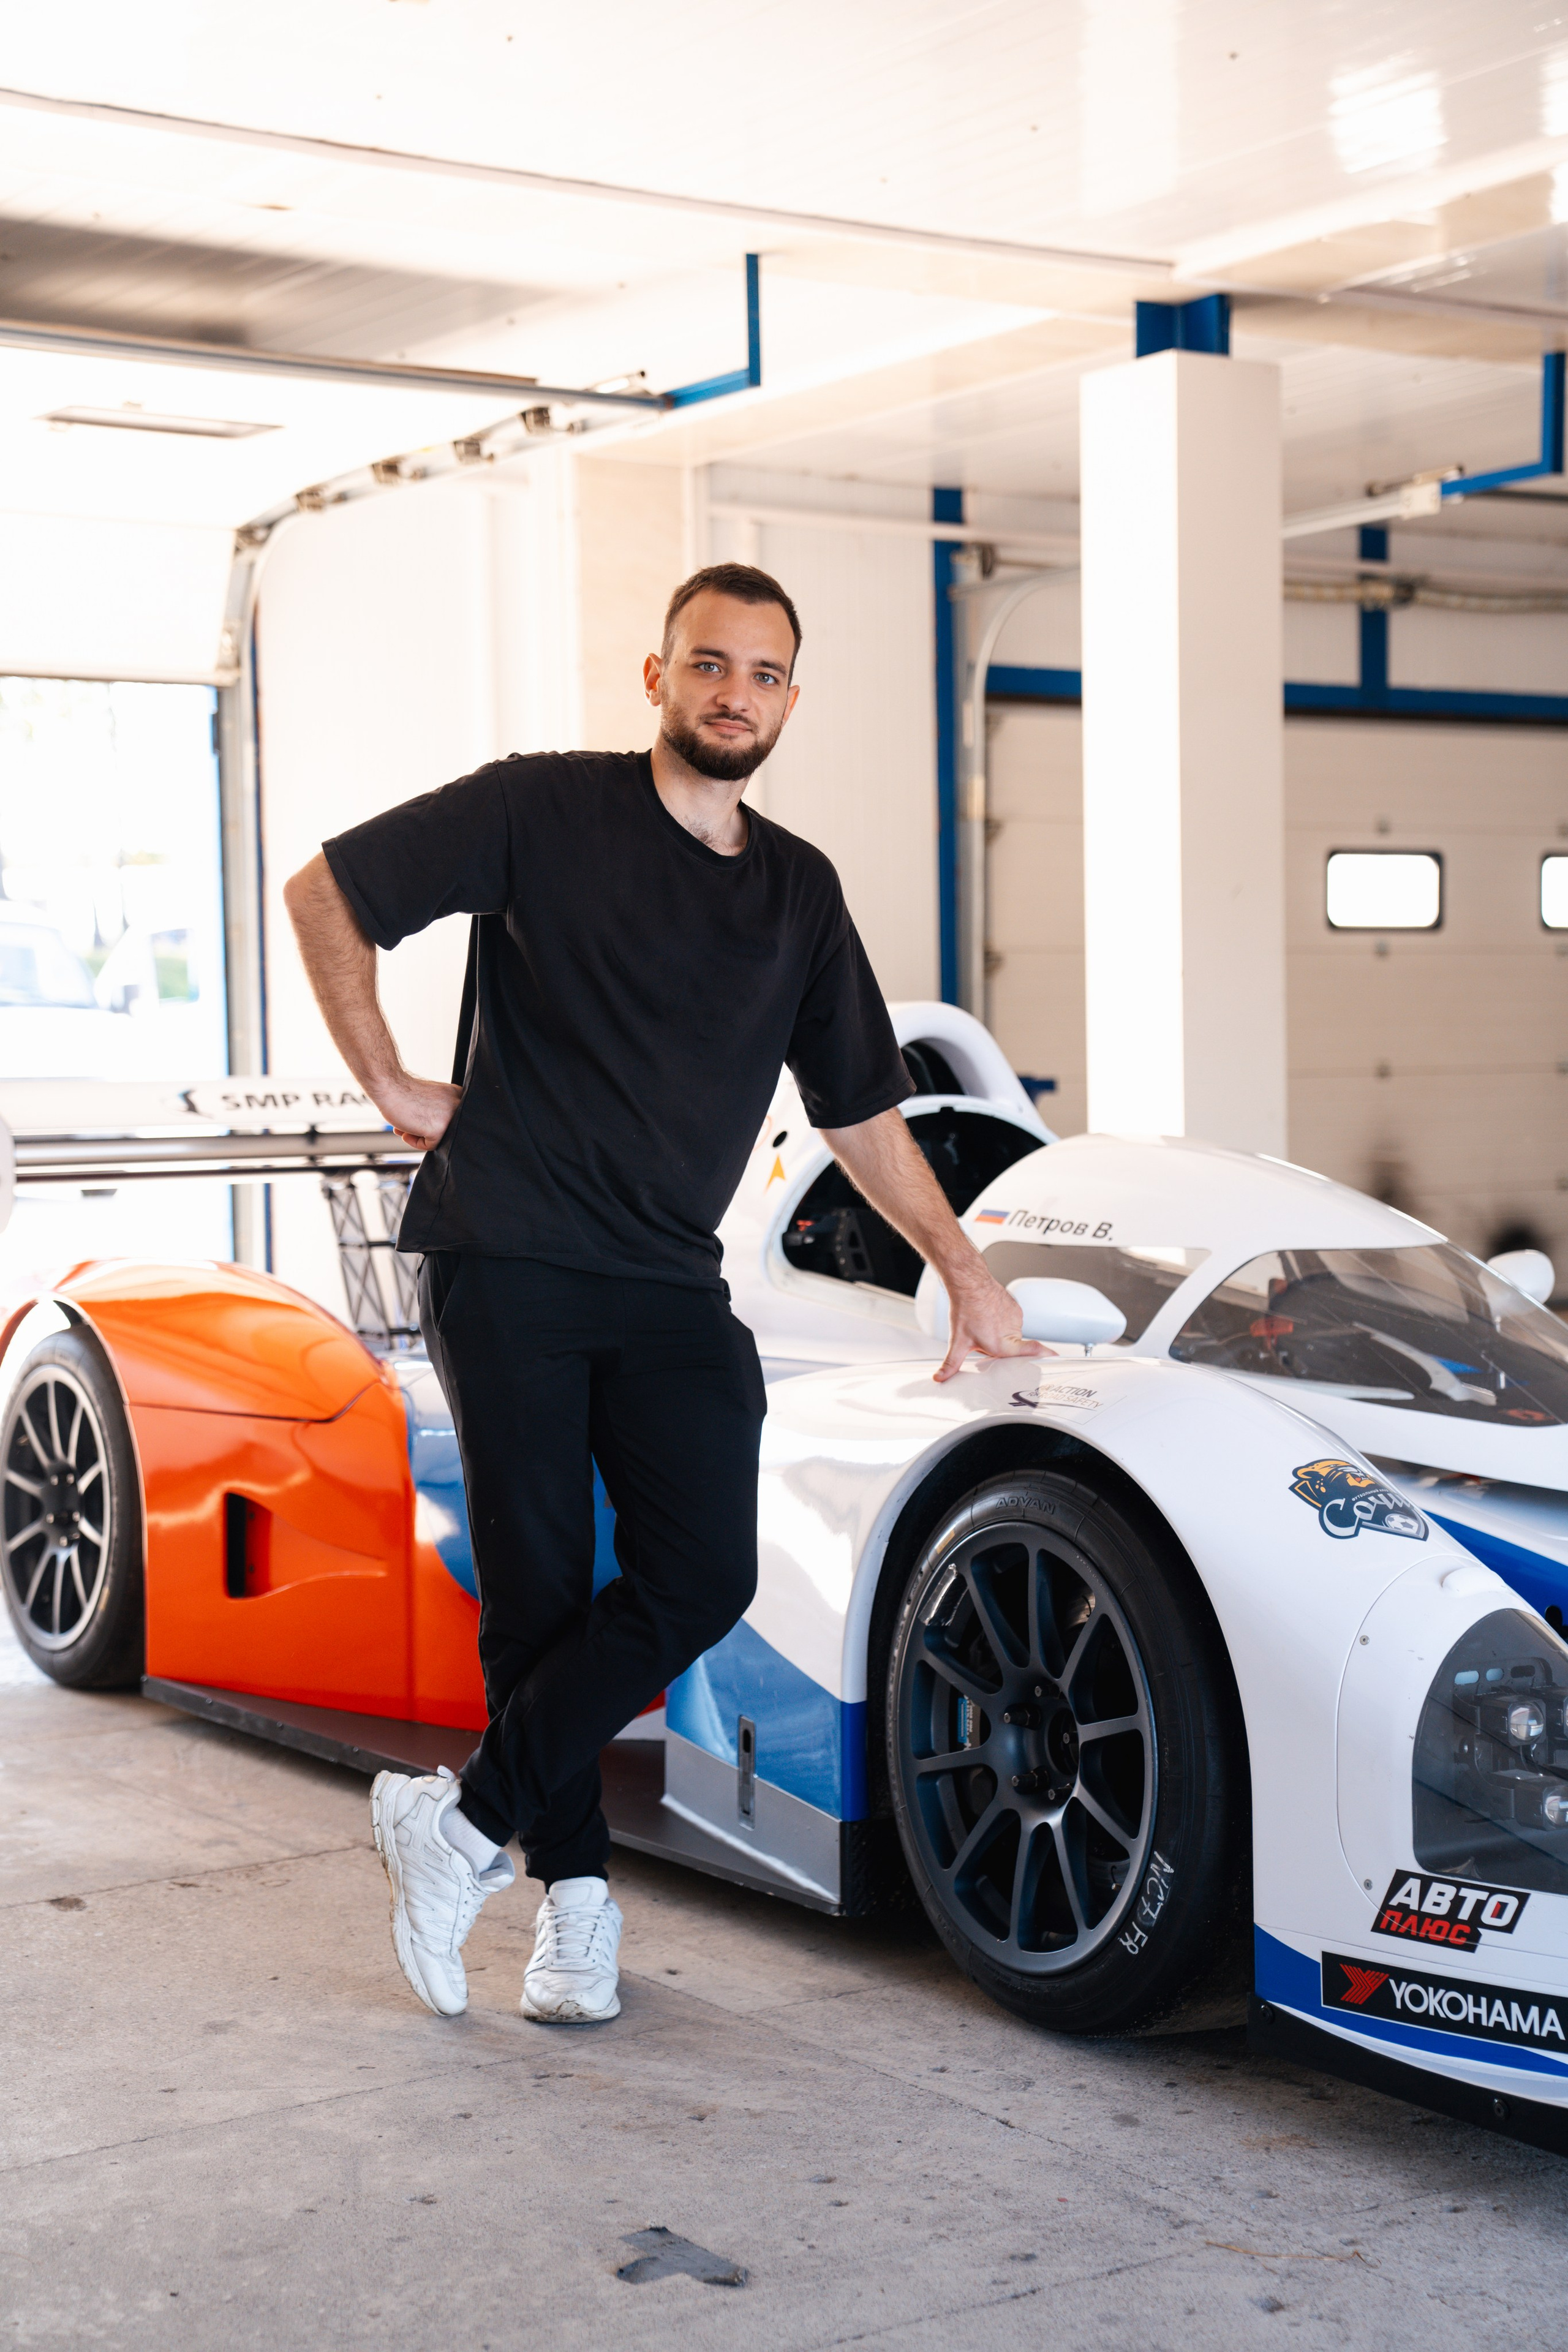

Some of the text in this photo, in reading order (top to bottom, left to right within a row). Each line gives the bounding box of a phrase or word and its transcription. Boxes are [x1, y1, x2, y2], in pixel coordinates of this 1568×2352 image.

[222, 1092, 371, 1110] SMP RA
[1009, 1209, 1113, 1242] Петров В.
[1039, 1392, 1065, 1401] ROAD
[1063, 1395, 1104, 1409] SAFETY
[1052, 1385, 1098, 1398] ACTION
[995, 1496, 1056, 1515] ADVAN
[1388, 1877, 1519, 1928] АВТО
[1118, 1921, 1148, 1955] FR
[1379, 1909, 1471, 1945] ПЛЮС
[1389, 1978, 1566, 2041] YOKOHAMA
